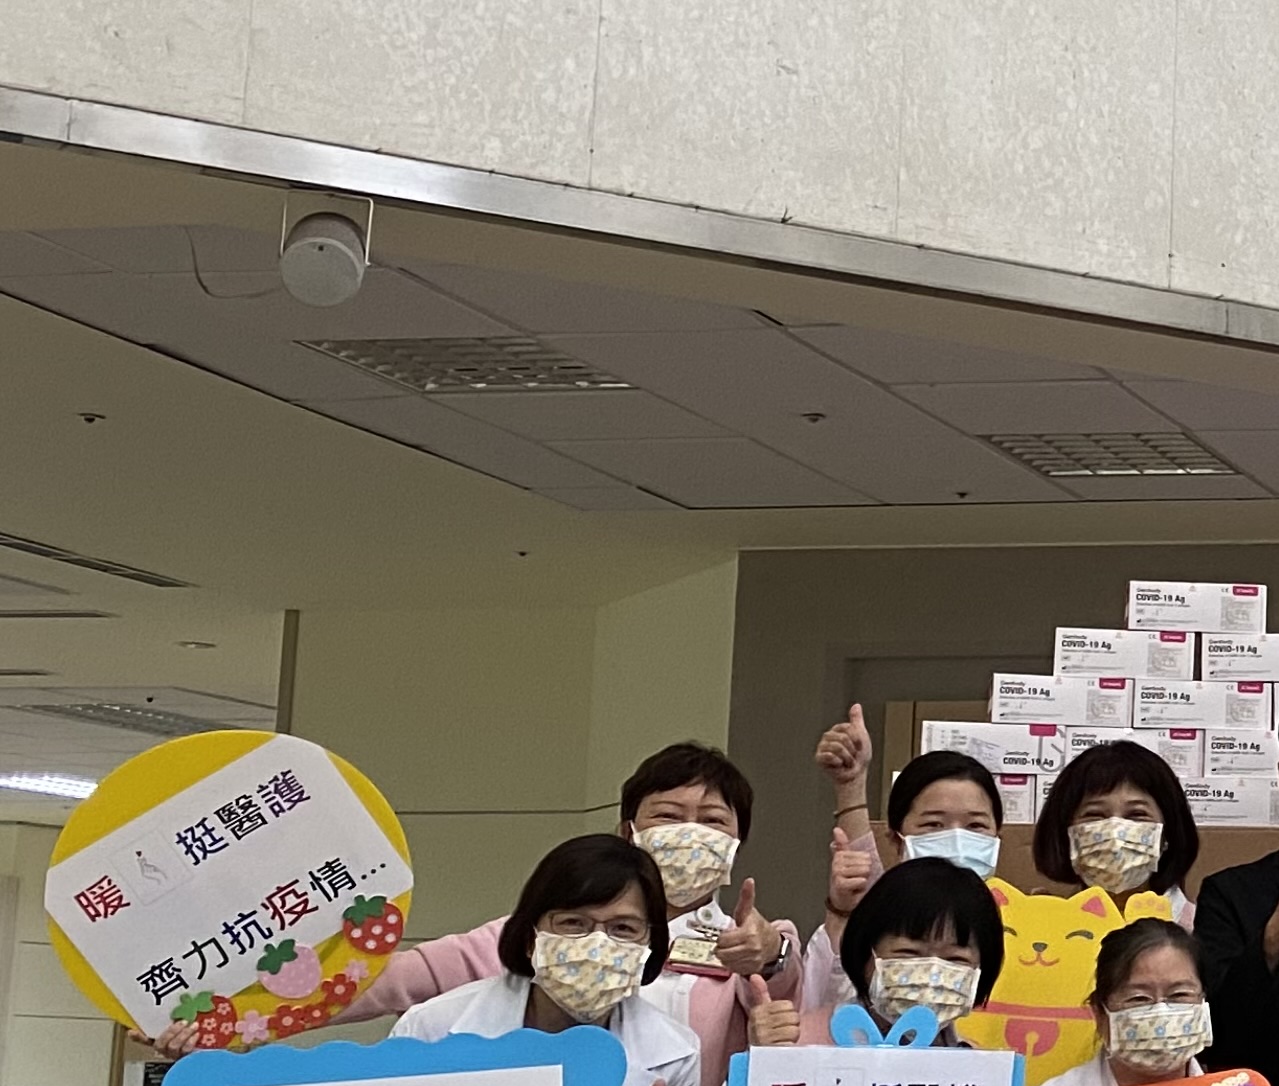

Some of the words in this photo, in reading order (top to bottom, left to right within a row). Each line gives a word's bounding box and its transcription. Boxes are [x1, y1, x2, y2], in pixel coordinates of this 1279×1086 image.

[73, 875, 131, 923] 暖
[175, 769, 311, 866] 挺醫護
